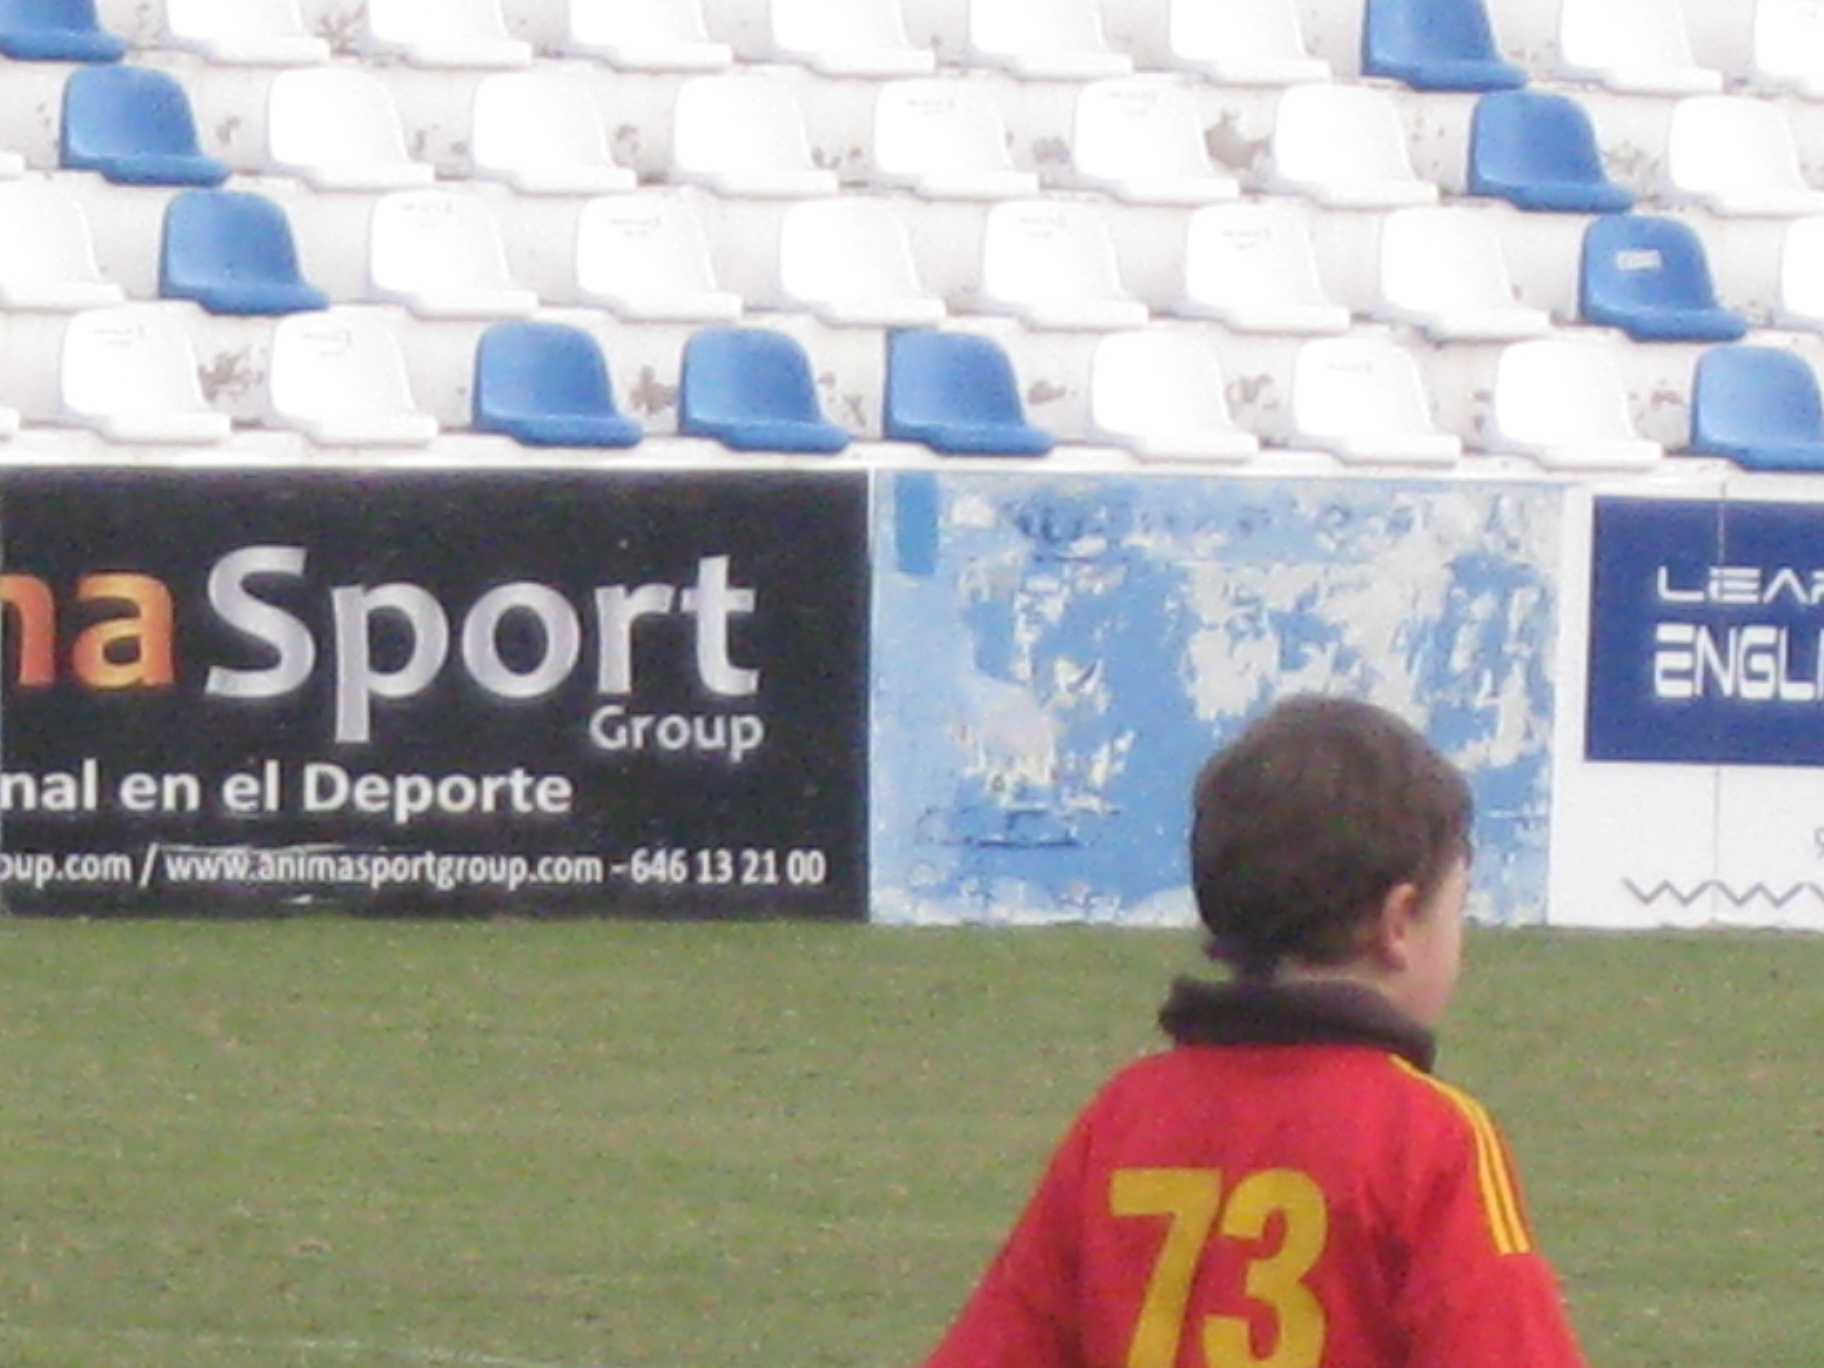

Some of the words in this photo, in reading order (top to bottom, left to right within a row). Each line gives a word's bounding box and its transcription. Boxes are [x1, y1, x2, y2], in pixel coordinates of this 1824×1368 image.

[589, 704, 764, 763] Group
[119, 774, 200, 811] en
[223, 760, 279, 812] el
[303, 763, 573, 824] Deporte
[165, 850, 603, 892] www.animasportgroup.com
[697, 849, 733, 884] 13
[741, 849, 779, 885] 21
[786, 849, 826, 885] 00
